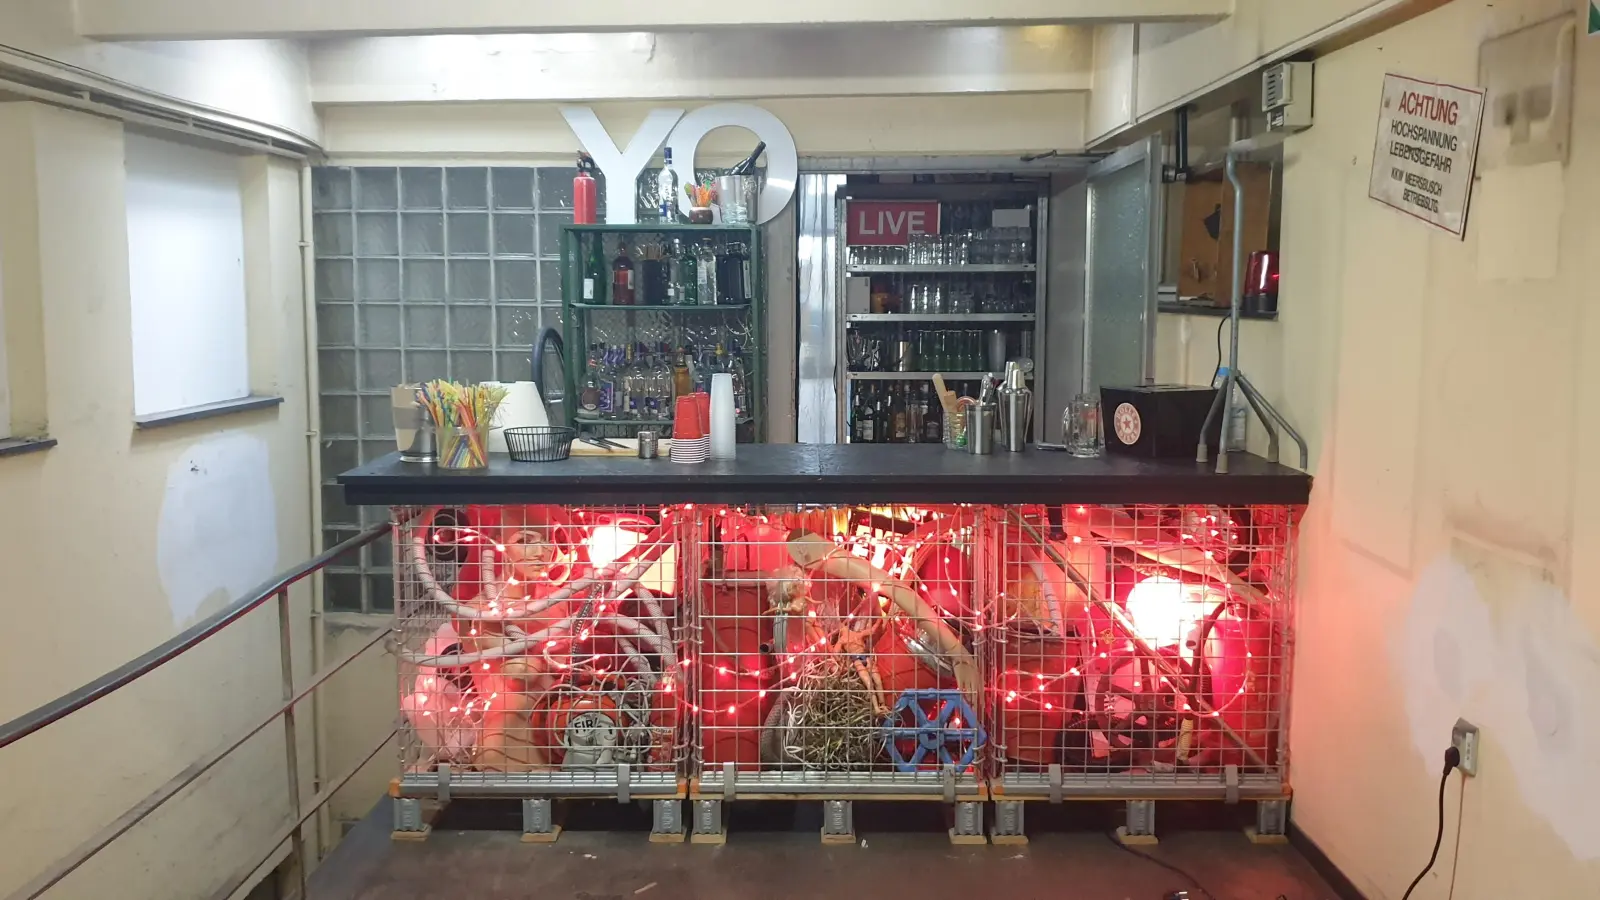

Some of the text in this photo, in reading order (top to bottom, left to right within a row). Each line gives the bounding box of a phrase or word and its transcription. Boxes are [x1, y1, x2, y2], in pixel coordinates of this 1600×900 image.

[1399, 92, 1459, 125] ACHTUNG
[1391, 120, 1458, 151] HOCHSPANNUNG
[560, 102, 797, 225] YO
[1389, 141, 1452, 173] LEBENSGEFAHR
[1405, 172, 1443, 197] MEERSBUSCH
[859, 210, 925, 235] LIVE
